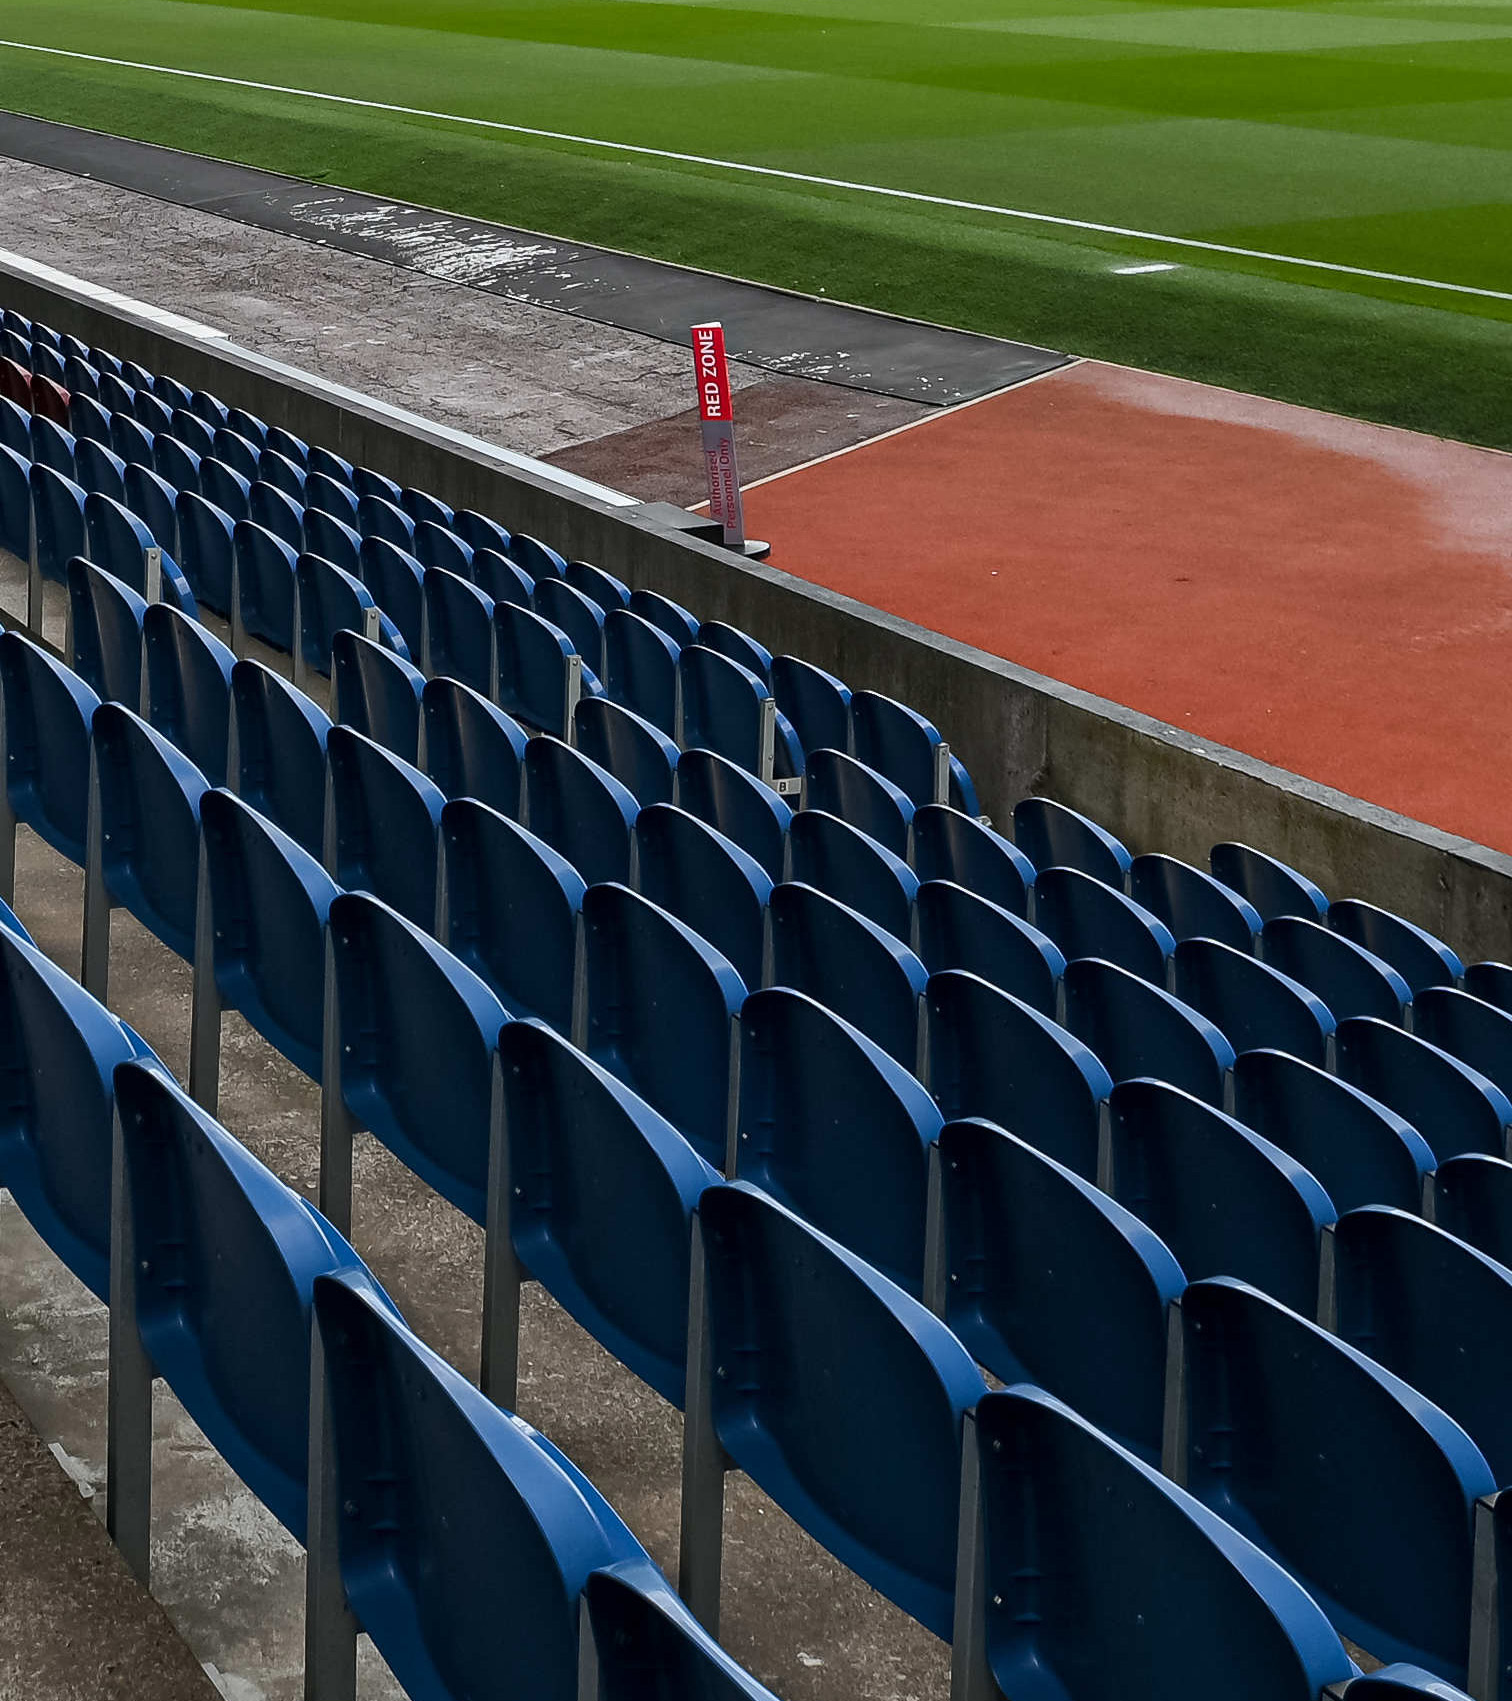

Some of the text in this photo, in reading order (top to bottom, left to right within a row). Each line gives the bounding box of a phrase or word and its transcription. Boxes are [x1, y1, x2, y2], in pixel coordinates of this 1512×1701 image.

[698, 329, 722, 418] RED ZONE
[708, 449, 723, 518] Authorised
[719, 437, 737, 529] Personnel Only
[779, 781, 787, 793] B
